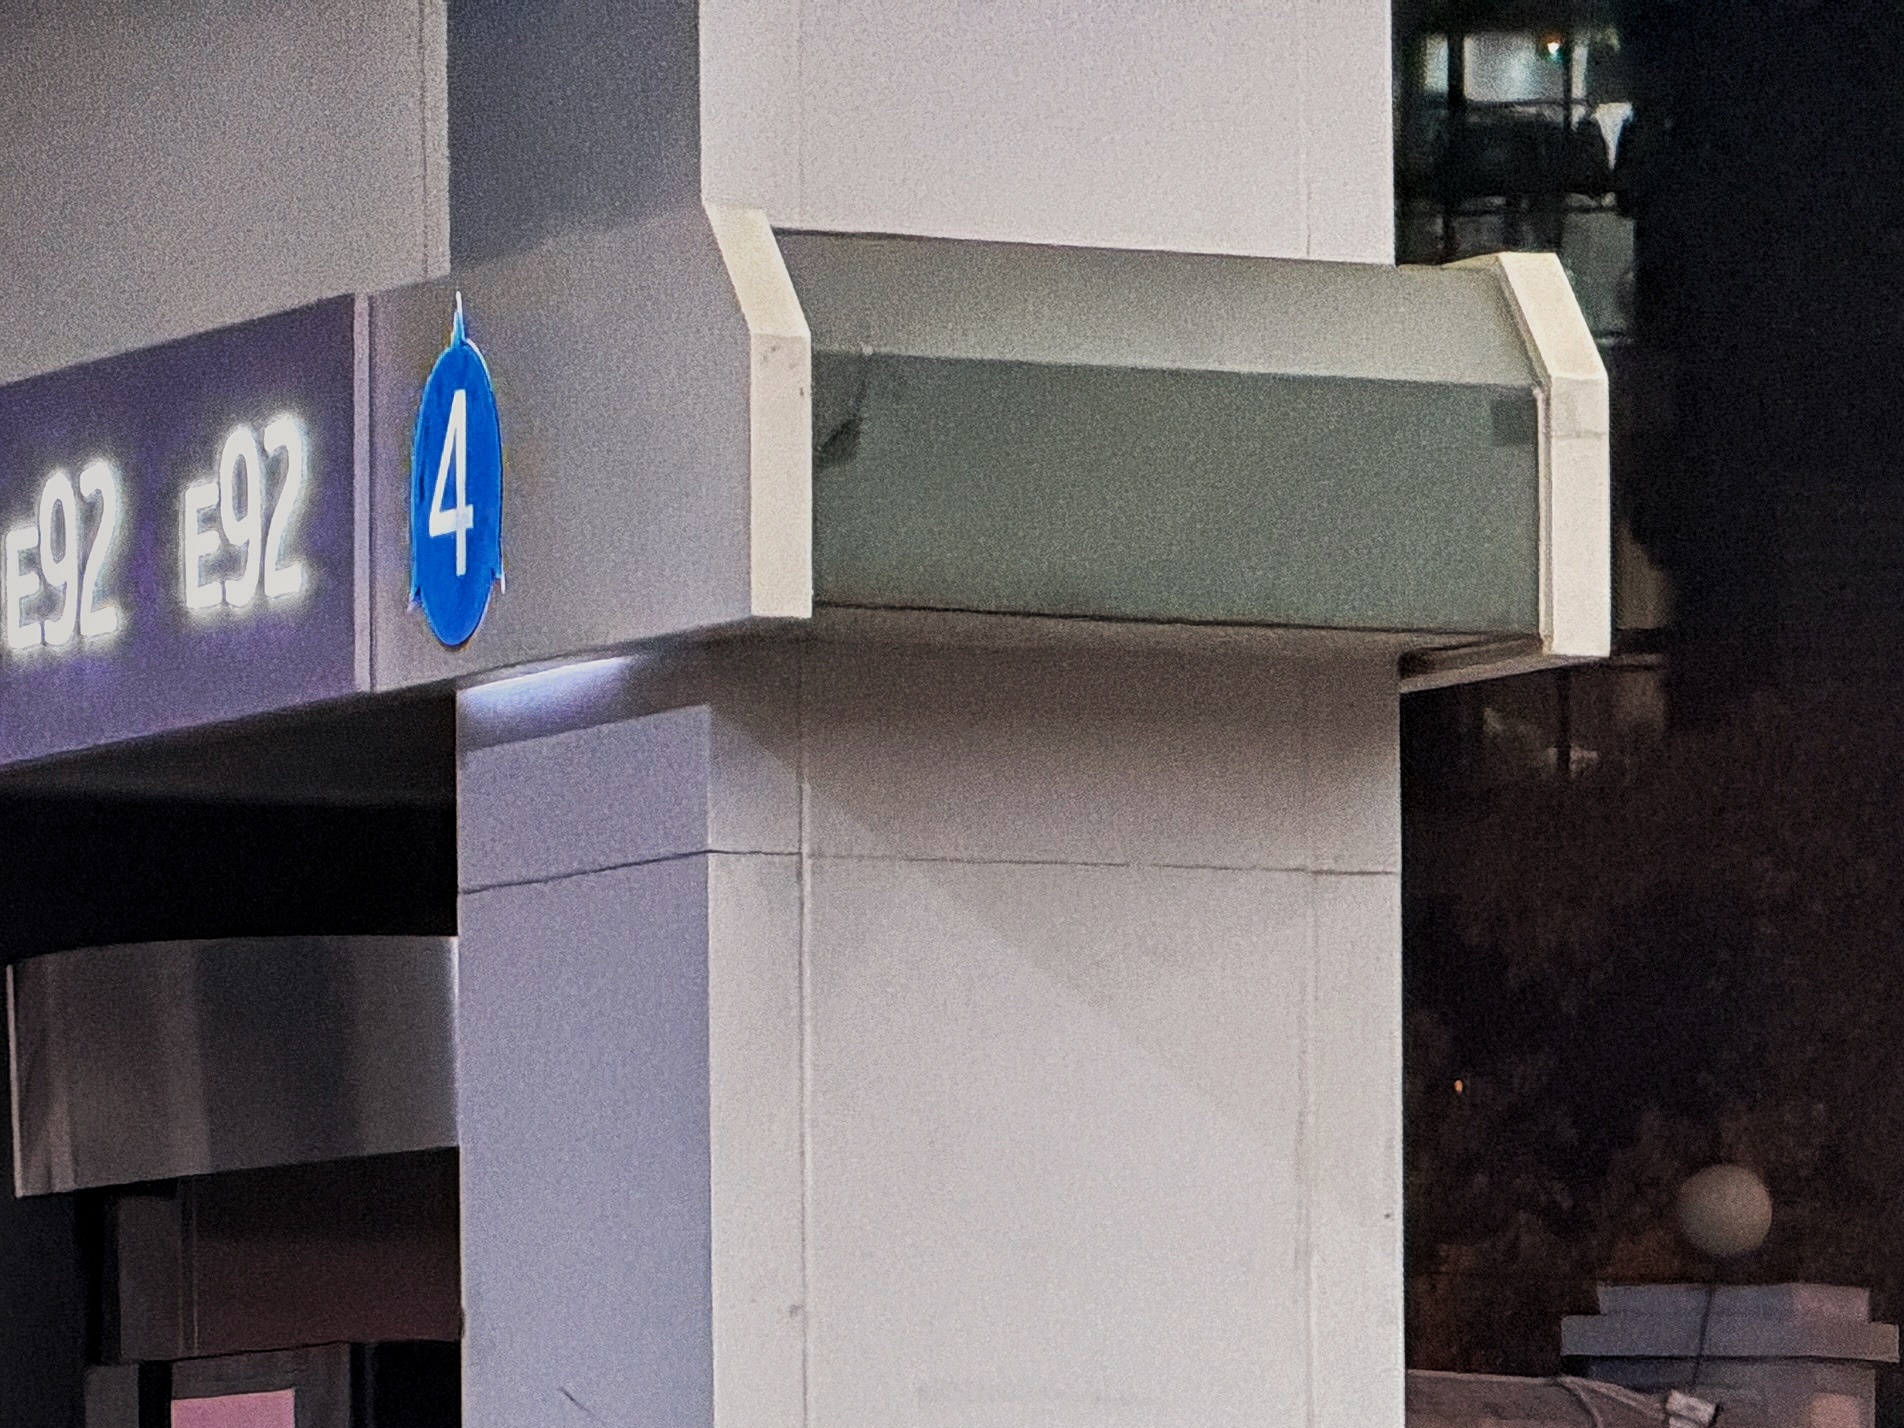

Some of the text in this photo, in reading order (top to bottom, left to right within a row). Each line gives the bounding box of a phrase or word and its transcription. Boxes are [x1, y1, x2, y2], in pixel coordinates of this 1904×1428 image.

[2, 412, 309, 652] E92 E92
[428, 389, 476, 577] 4
